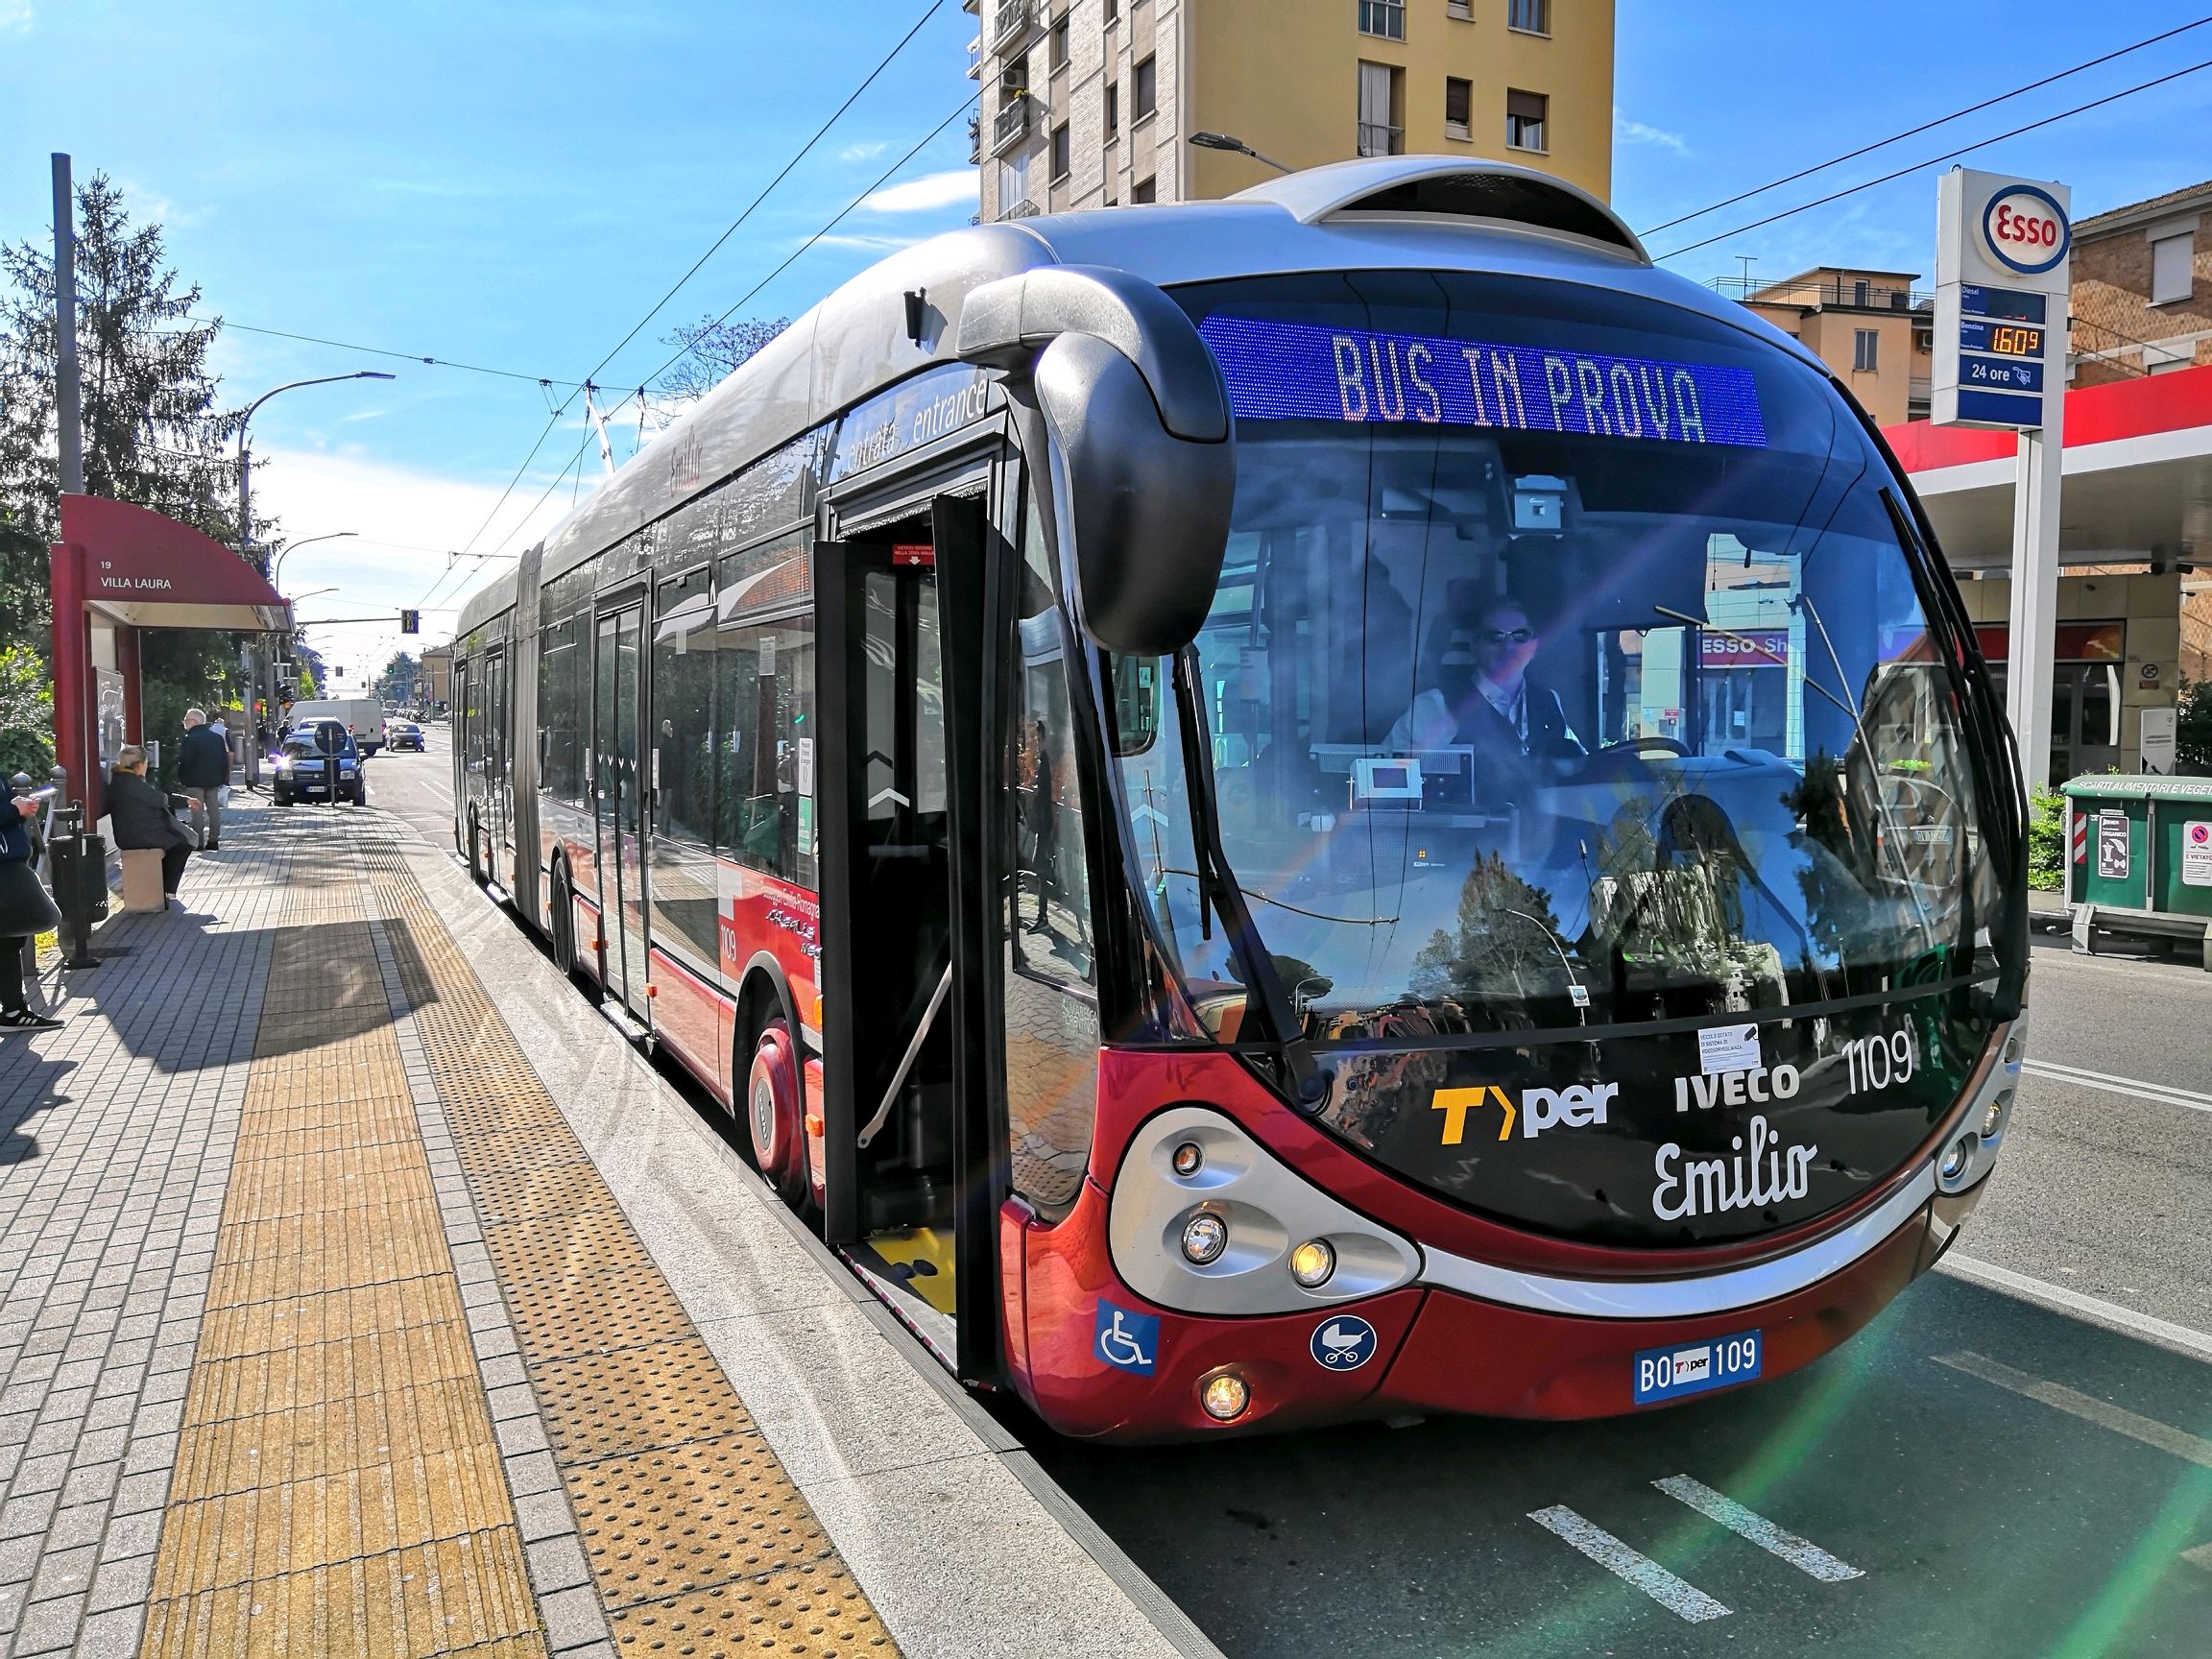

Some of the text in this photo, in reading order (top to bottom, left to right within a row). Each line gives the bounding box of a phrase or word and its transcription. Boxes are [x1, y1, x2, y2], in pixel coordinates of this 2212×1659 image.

[1332, 334, 1706, 445] BUS IN PROVA
[1971, 364, 2010, 381] 24 ore
[848, 378, 987, 471] entrata entrance
[101, 561, 111, 569] 19
[101, 577, 172, 589] VILLA LAURA
[1702, 638, 1756, 654] ESSO
[2111, 781, 2170, 794] ALIMENTARI
[720, 924, 737, 962] 1109
[1841, 1030, 1912, 1095] 1109
[1674, 1064, 1800, 1114] IVECO
[1652, 1115, 1818, 1221] Emilio
[1716, 1337, 1755, 1376] 109
